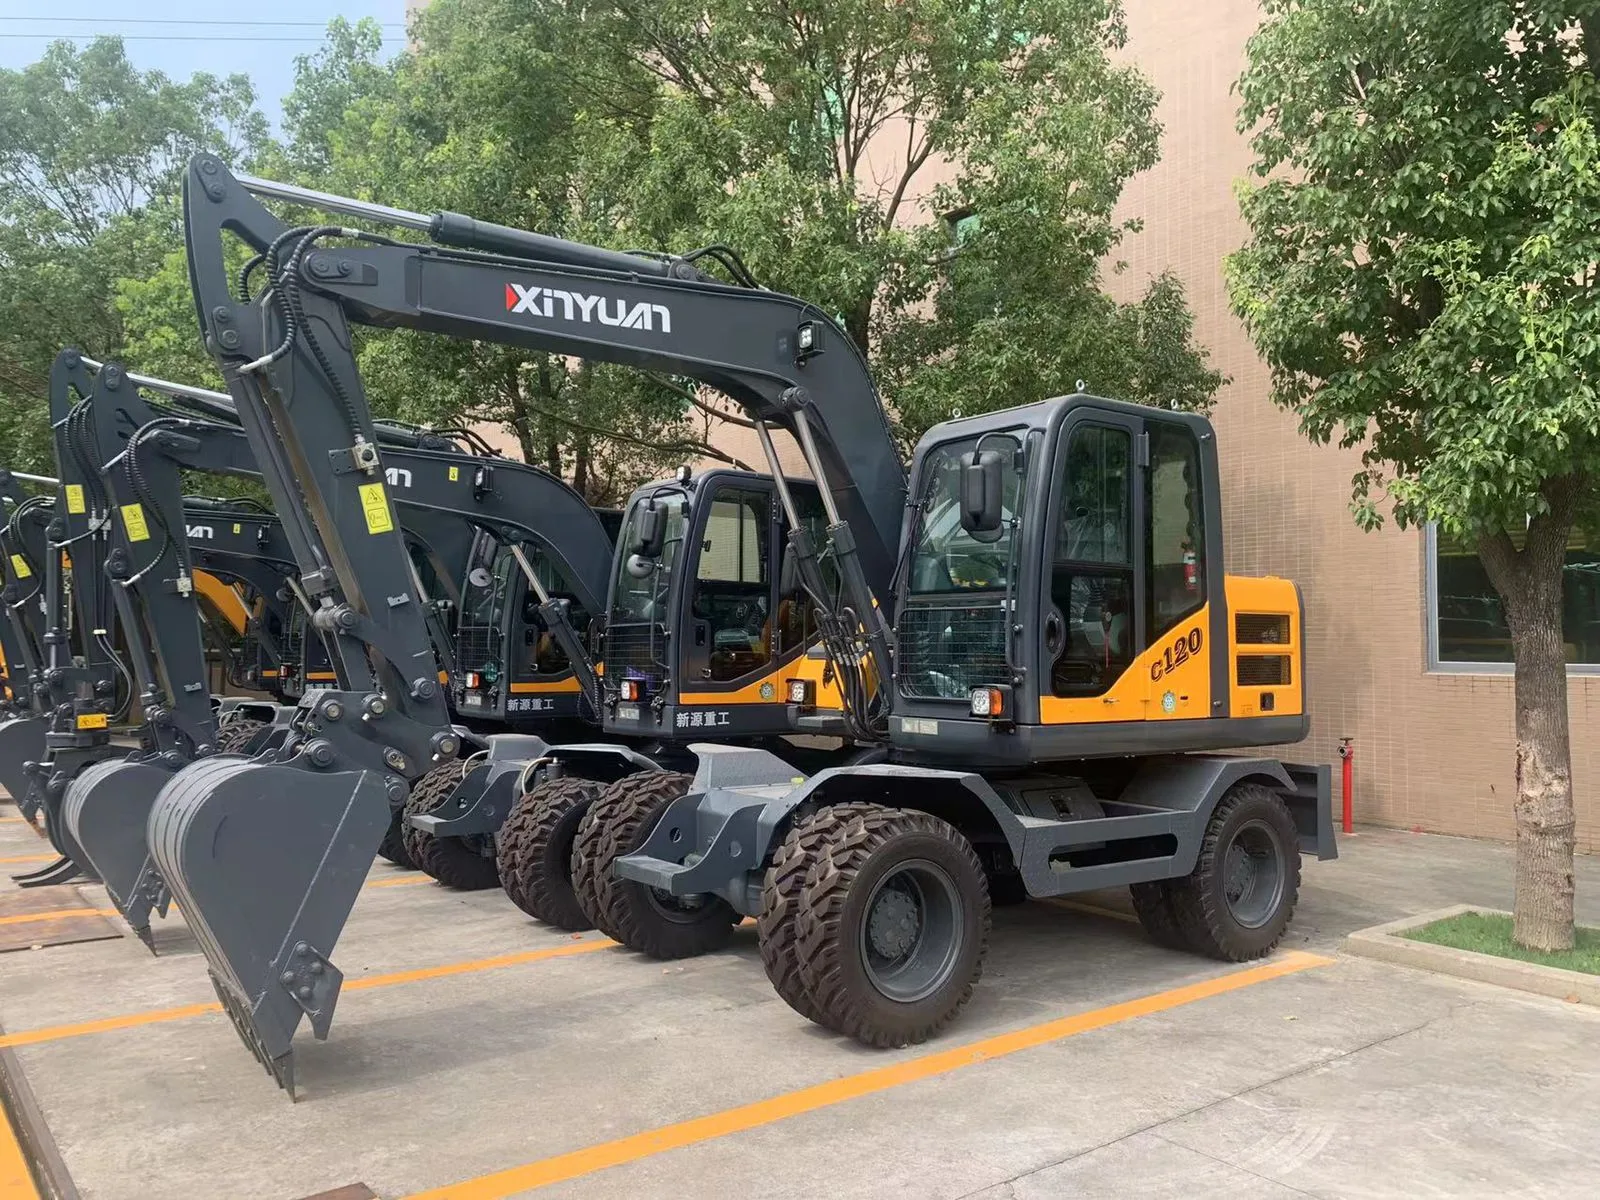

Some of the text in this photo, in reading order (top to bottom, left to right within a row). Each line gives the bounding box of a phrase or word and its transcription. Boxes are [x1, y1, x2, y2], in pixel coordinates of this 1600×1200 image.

[507, 698, 555, 712] 新源重工
[676, 711, 731, 728] 新源重工
